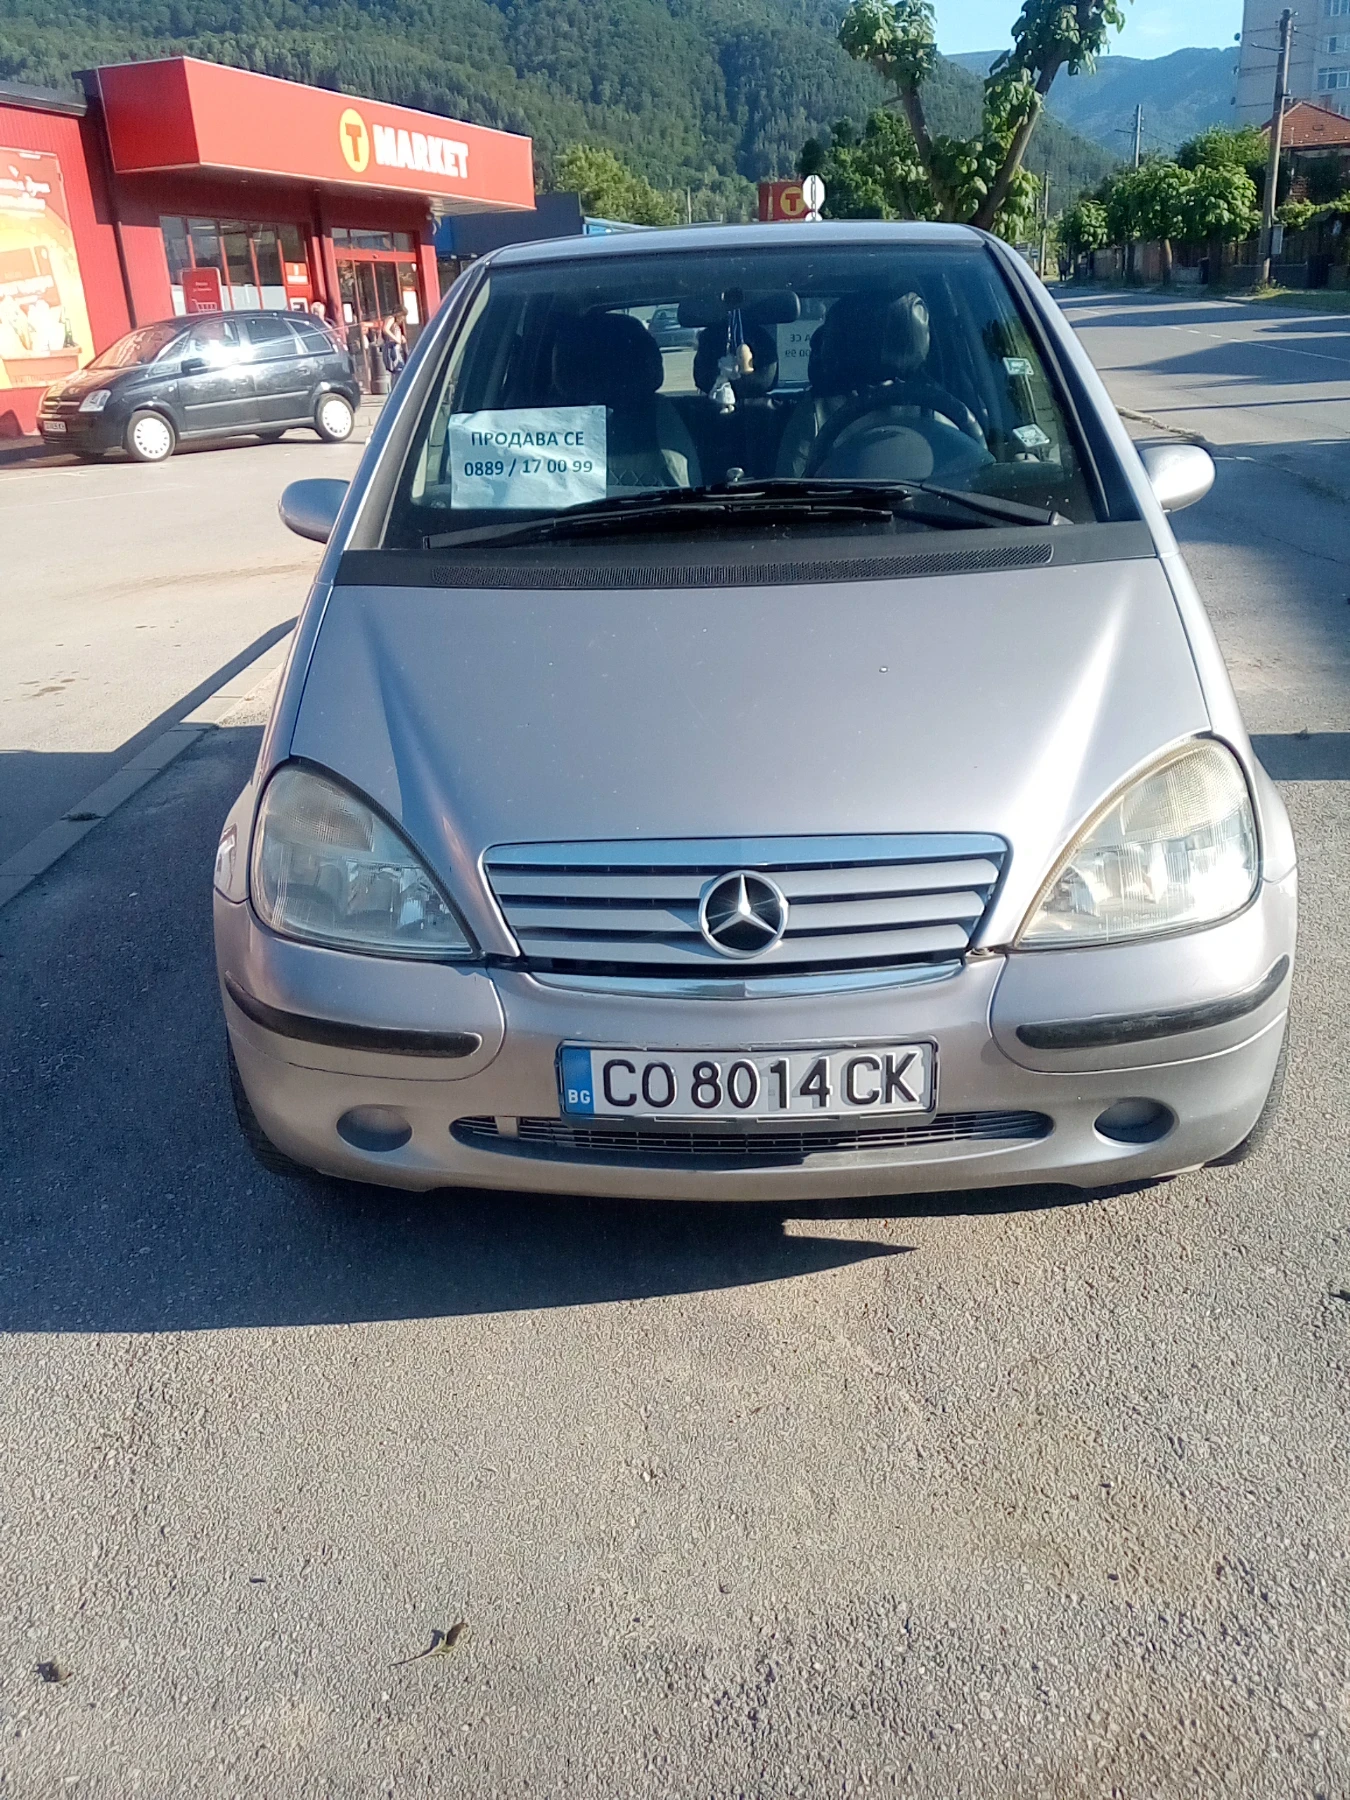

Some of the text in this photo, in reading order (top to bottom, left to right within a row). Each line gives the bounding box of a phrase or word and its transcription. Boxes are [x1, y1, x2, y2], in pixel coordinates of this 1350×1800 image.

[345, 122, 469, 179] T MARKET
[785, 192, 801, 212] T
[471, 431, 585, 448] ПРОДАВА СЕ
[464, 458, 593, 477] 0889 / 17 00 99
[602, 1051, 920, 1110] CO 8014 CK
[568, 1088, 591, 1104] BG
